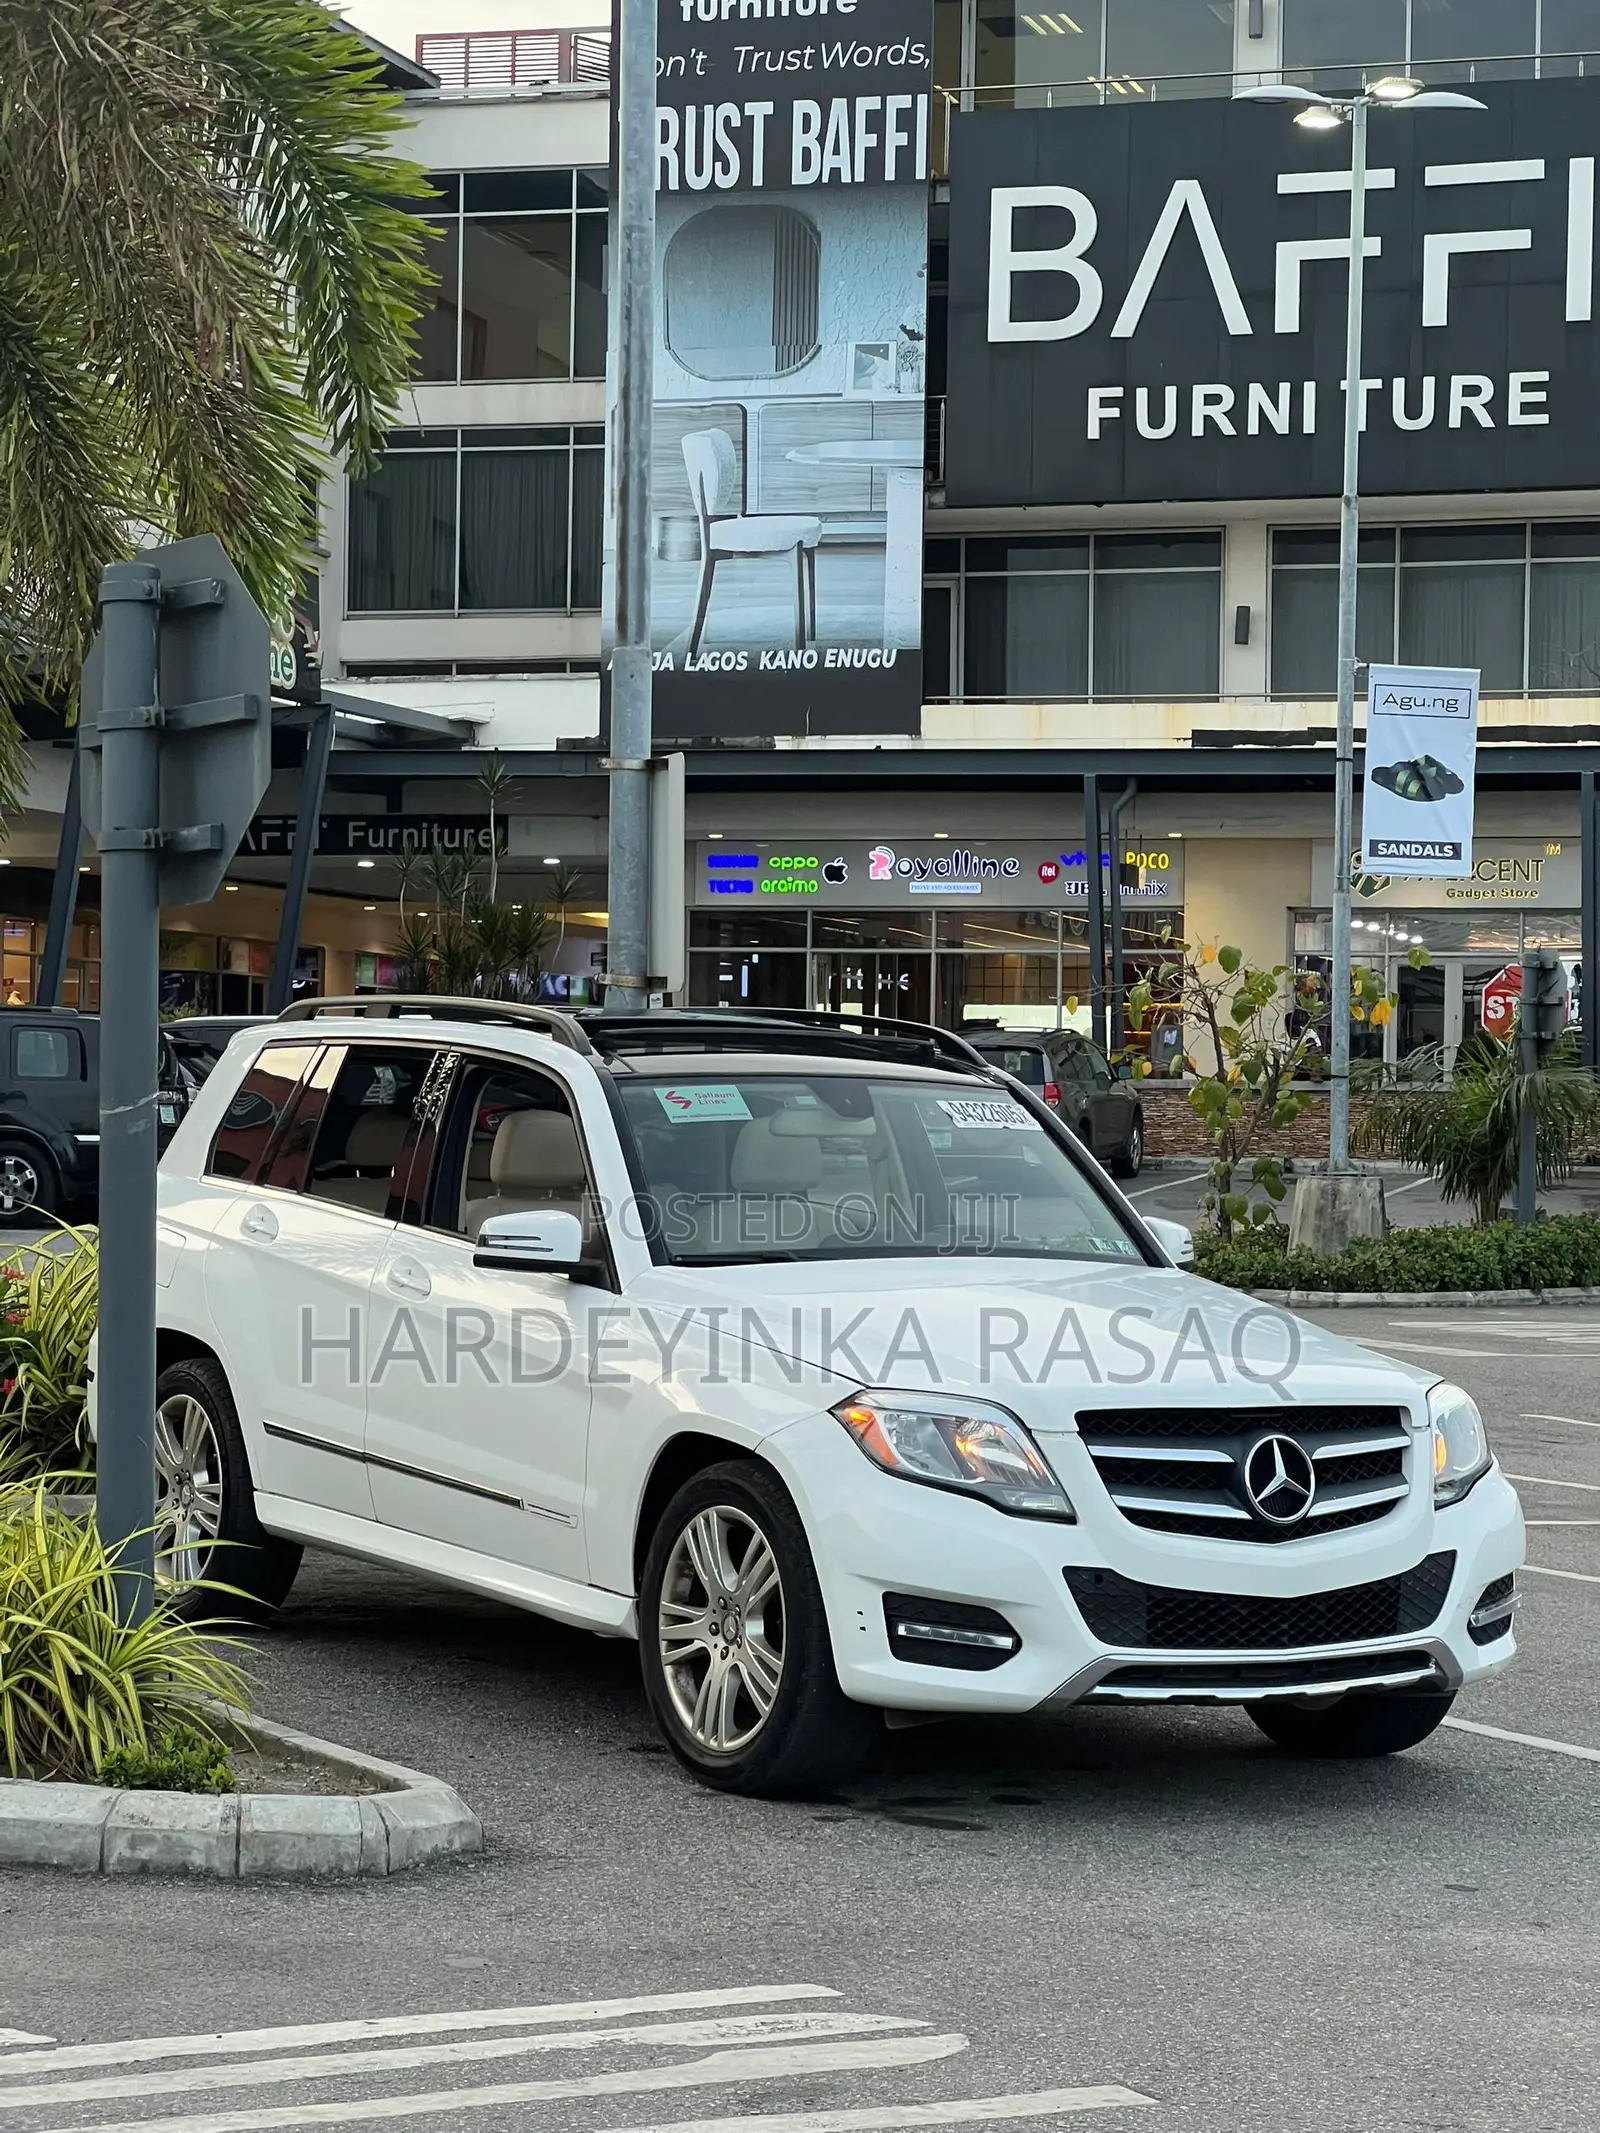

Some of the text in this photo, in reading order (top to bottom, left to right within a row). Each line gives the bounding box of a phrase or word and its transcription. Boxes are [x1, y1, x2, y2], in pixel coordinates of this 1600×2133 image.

[655, 36, 931, 78] on't Trust Words,
[618, 93, 928, 191] RUST BAFFI
[986, 156, 1595, 344] BAFFI
[1086, 370, 1551, 440] FURNITURE
[684, 651, 748, 672] LAGOS
[759, 649, 819, 670] KANO
[823, 648, 898, 669] ENUGU
[1382, 692, 1460, 713] Agu.ng
[347, 820, 495, 849] Furniture
[1126, 851, 1170, 870] POCO
[1377, 843, 1454, 857] SANDALS
[768, 856, 819, 870] oppo
[868, 845, 1020, 881] Royalline
[1041, 865, 1056, 877] itel
[760, 876, 819, 893] oraimo
[1446, 887, 1539, 899] Gadget Store
[1486, 995, 1521, 1019] ST
